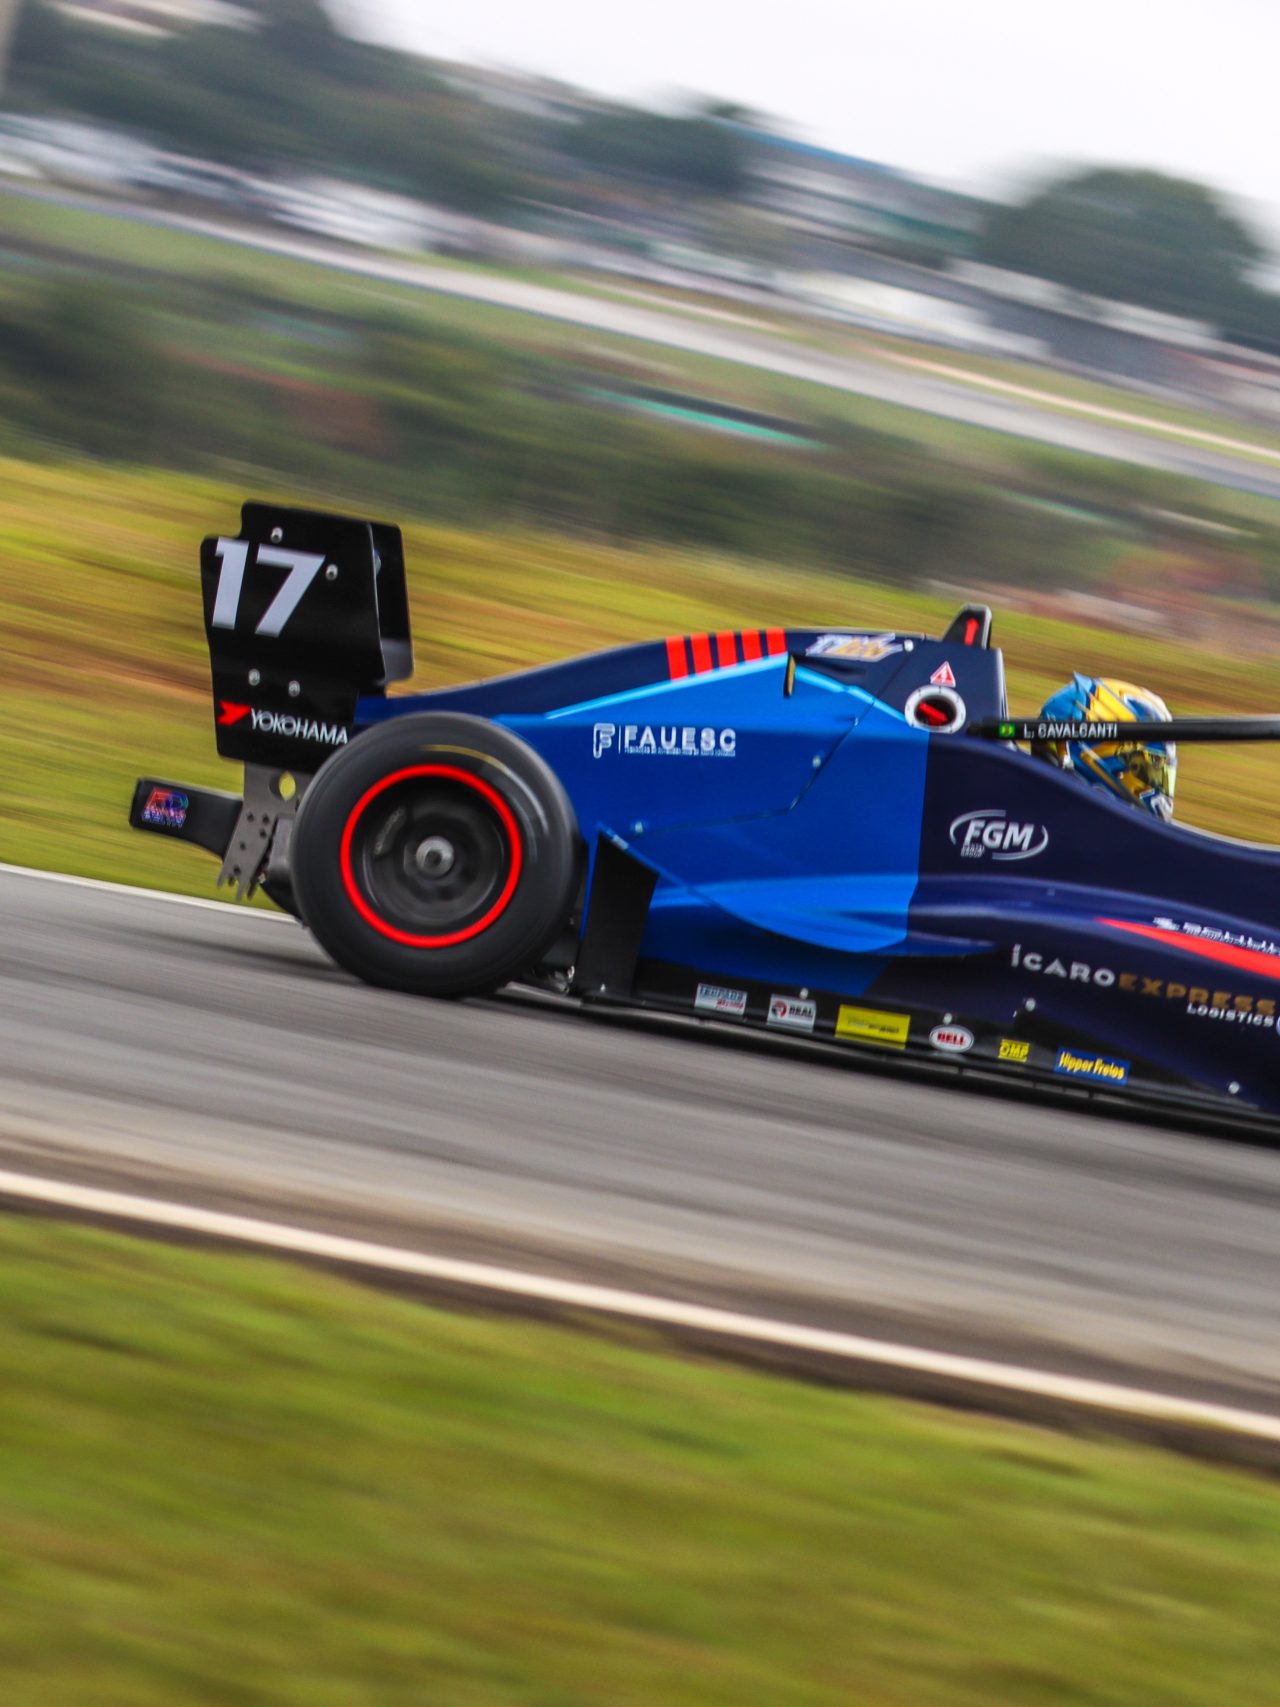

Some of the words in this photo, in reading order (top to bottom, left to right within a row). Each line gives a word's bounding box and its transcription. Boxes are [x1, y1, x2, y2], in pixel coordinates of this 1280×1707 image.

[211, 535, 326, 638] 17
[251, 707, 349, 745] YOKOHAMA
[624, 724, 736, 752] FAUESC
[1037, 723, 1118, 739] CAVALCANTI
[963, 819, 1035, 851] FGM
[1186, 1002, 1275, 1028] LOGISTICS
[937, 1032, 965, 1045] BELL
[1000, 1042, 1029, 1060] OMP
